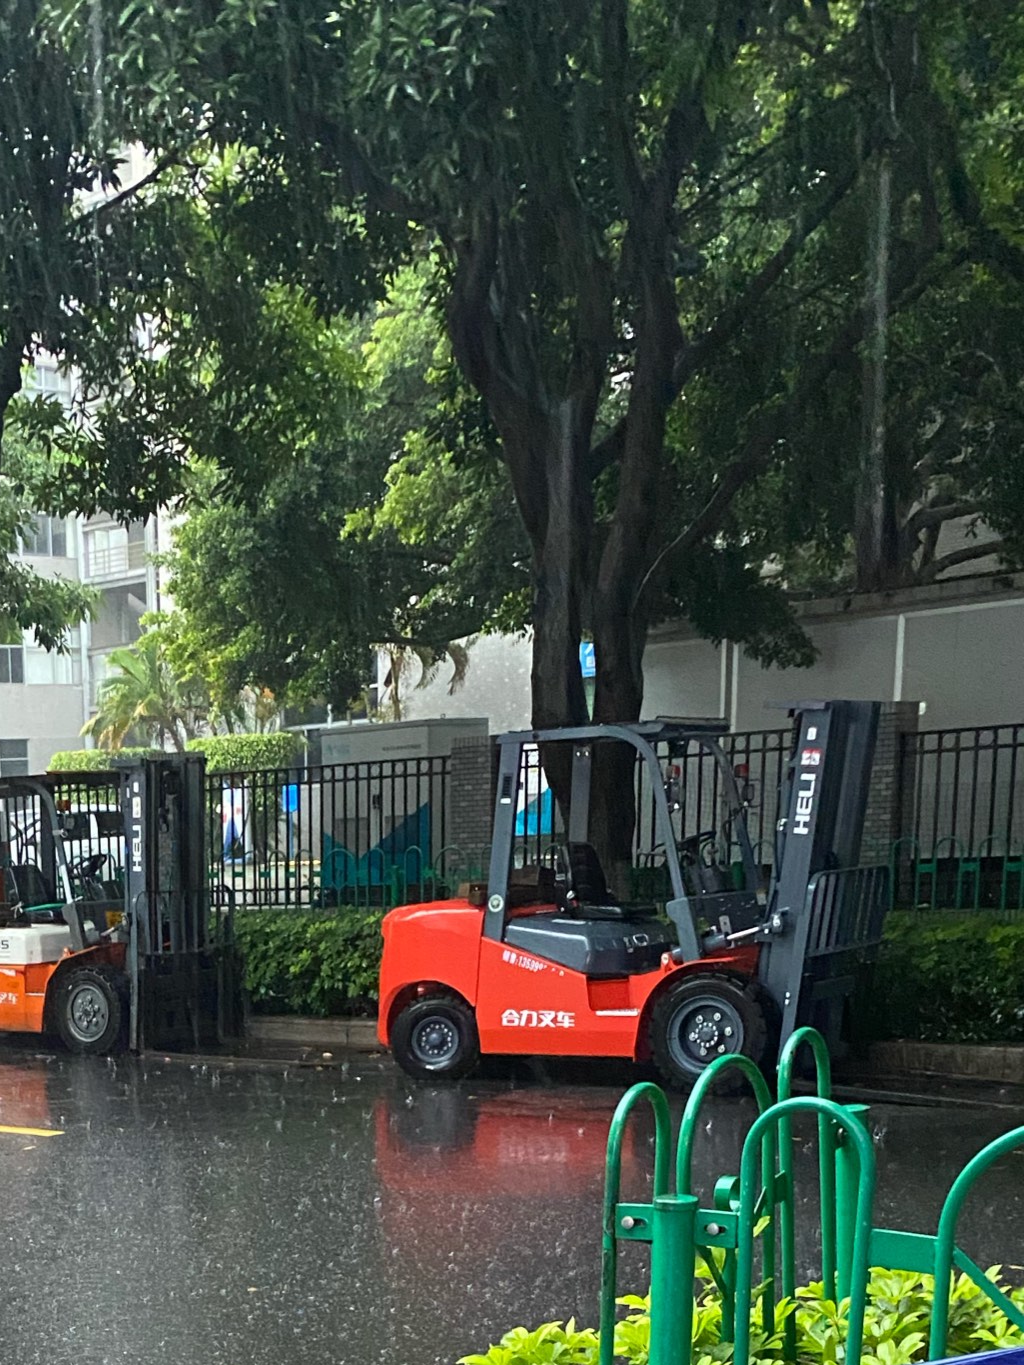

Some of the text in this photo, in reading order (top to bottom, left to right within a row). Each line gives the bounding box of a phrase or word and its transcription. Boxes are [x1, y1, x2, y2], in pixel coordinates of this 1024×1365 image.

[792, 773, 816, 835] HELI
[132, 825, 142, 872] HELI
[501, 1008, 575, 1028] 合力叉车
